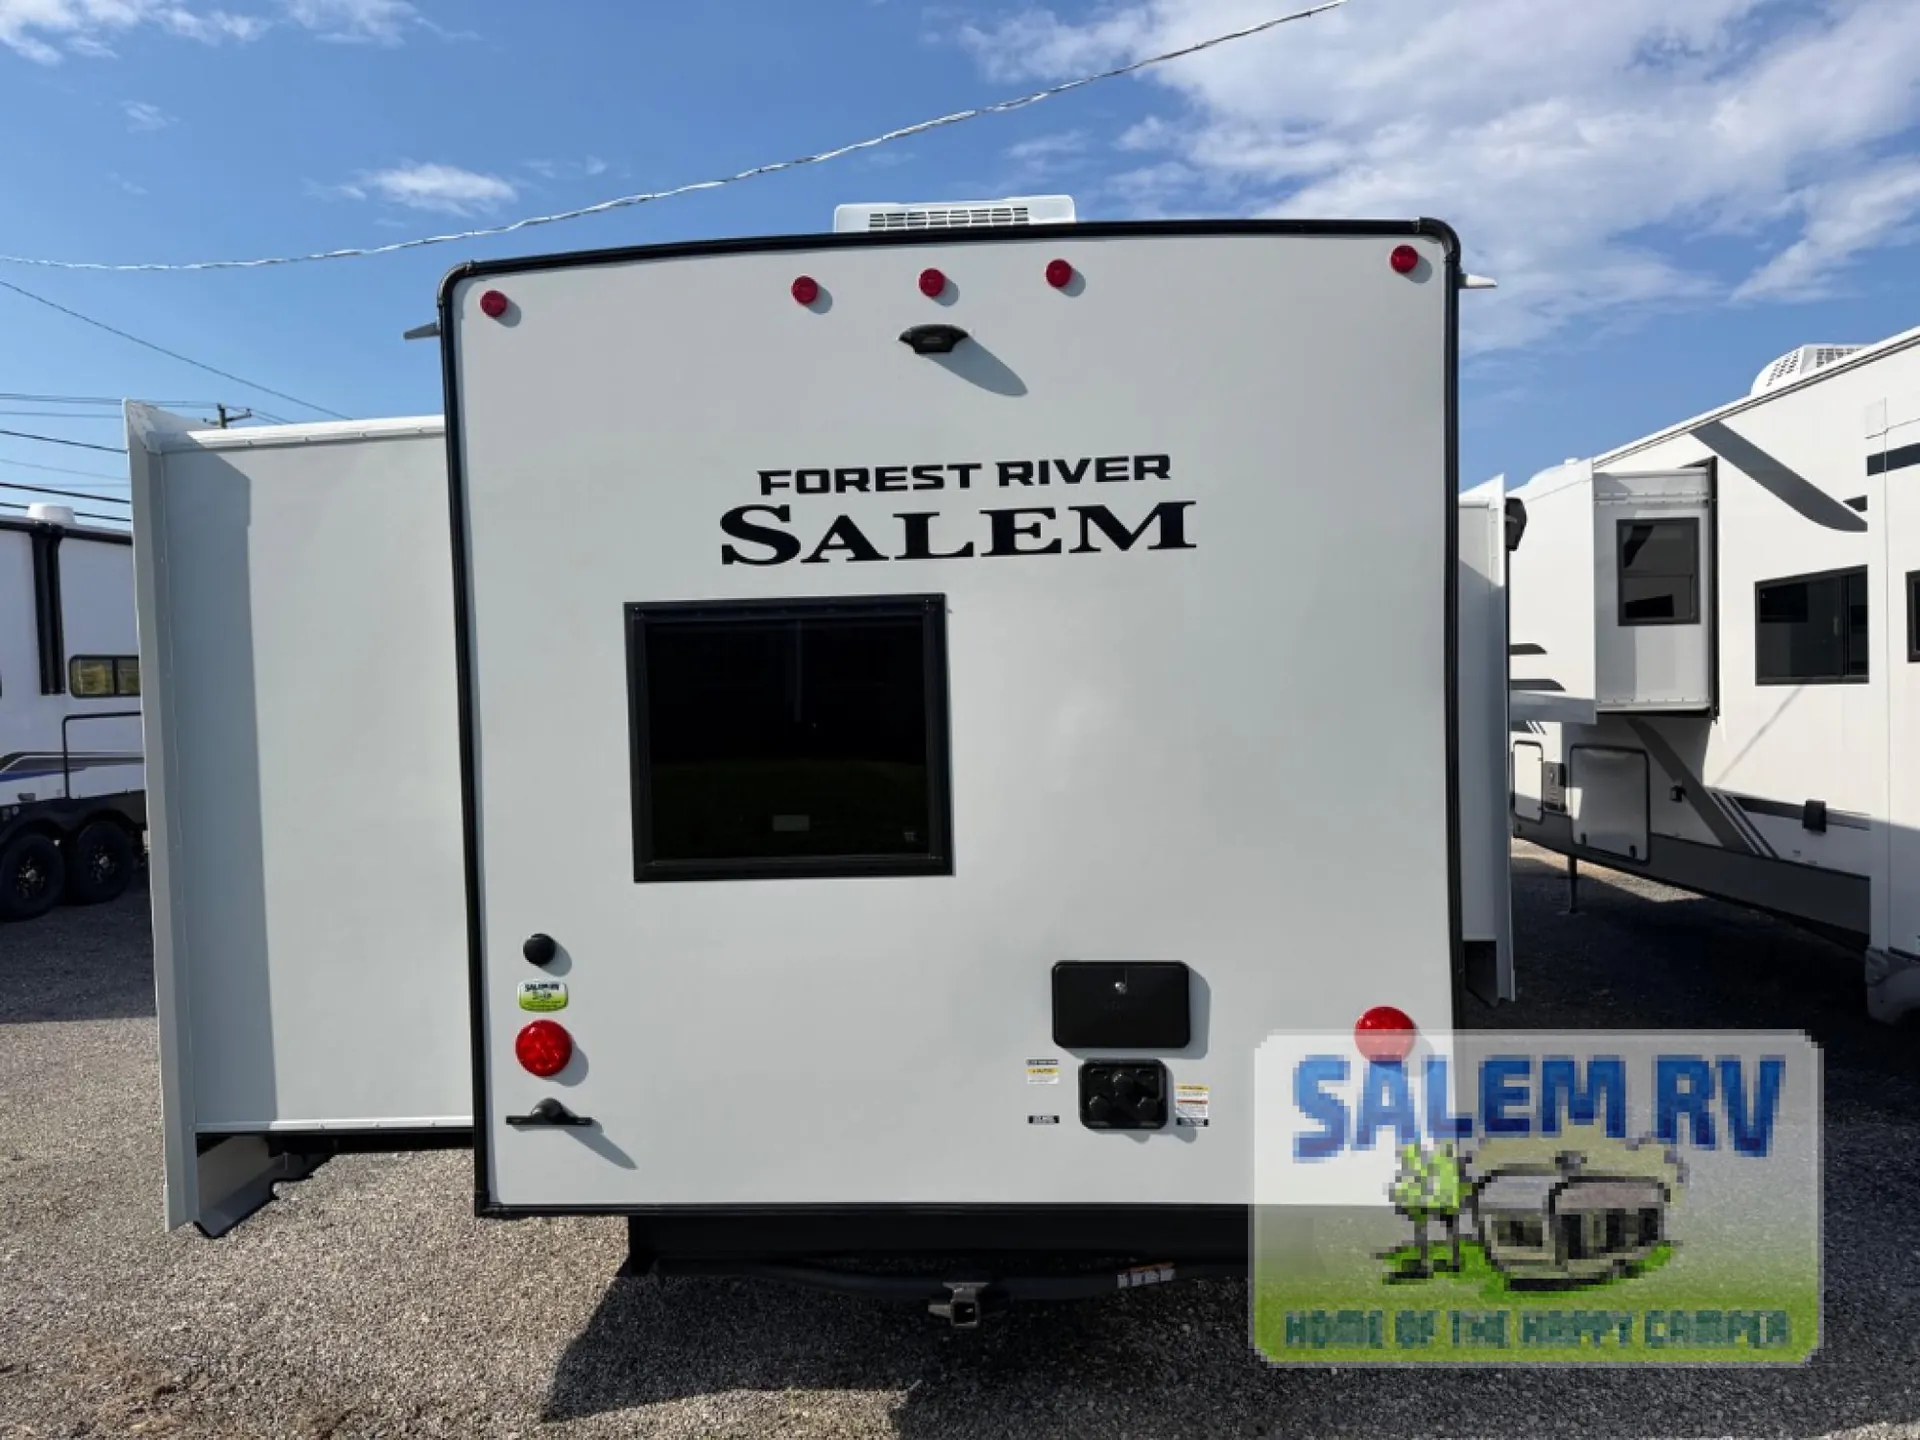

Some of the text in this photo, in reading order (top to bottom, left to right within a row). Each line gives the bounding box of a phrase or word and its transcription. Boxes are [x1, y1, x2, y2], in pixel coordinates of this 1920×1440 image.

[757, 454, 1172, 496] FOREST RIVER
[720, 500, 1197, 566] SALEM
